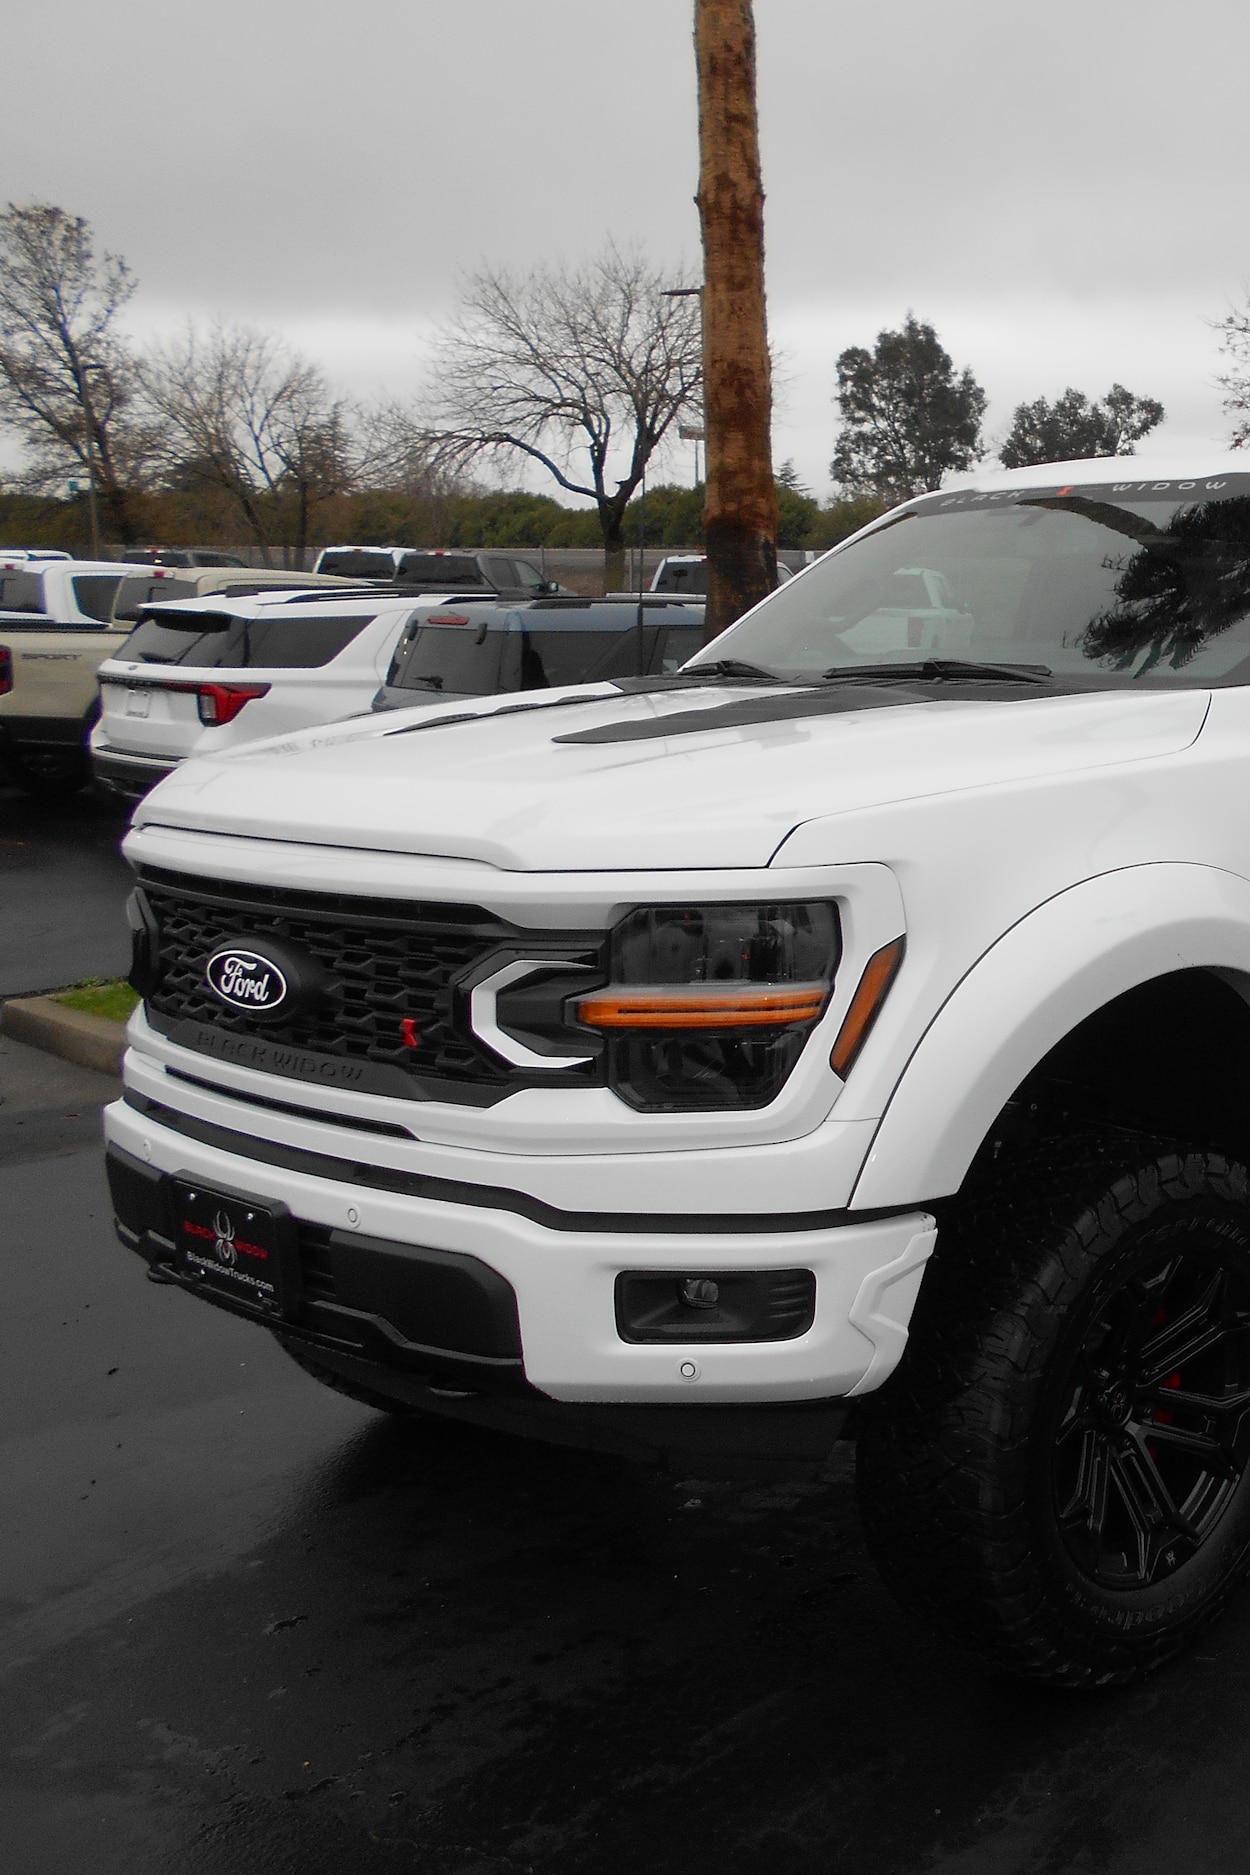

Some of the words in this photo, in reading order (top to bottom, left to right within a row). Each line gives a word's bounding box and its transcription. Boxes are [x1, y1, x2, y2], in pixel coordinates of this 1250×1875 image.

[939, 490, 1025, 506] BLACK
[1112, 480, 1228, 492] WIDOW
[21, 652, 83, 660] SPORT
[219, 955, 272, 1003] Ford
[197, 1031, 266, 1063] BLACK
[274, 1051, 363, 1080] WIDOW
